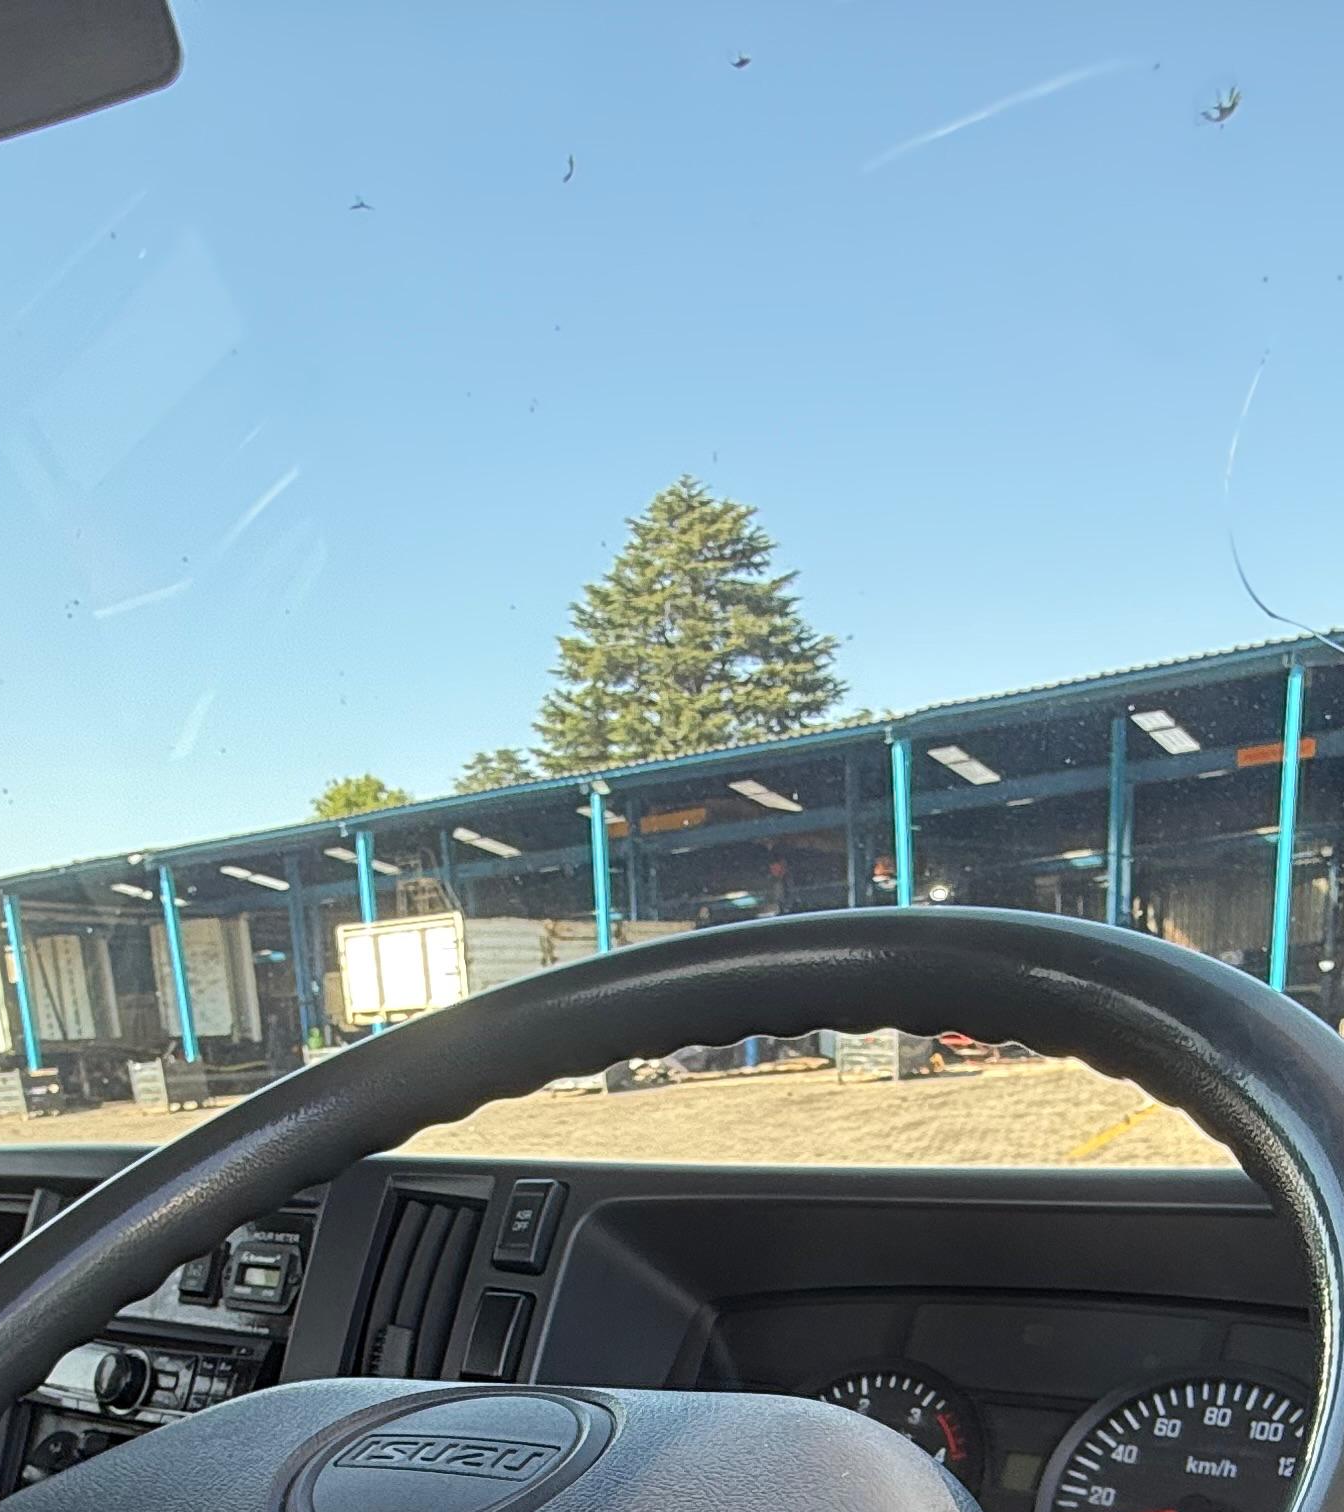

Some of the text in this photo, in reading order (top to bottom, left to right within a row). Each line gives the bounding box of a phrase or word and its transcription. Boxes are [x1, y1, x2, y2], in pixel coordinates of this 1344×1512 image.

[907, 1407, 922, 1425] 3
[1203, 1406, 1232, 1427] 80
[1153, 1418, 1182, 1438] 60
[1249, 1421, 1284, 1442] 100
[354, 1439, 546, 1472] ISUZU
[1111, 1444, 1139, 1465] 40
[1185, 1455, 1238, 1479] km/h
[1277, 1456, 1297, 1478] 12
[1090, 1486, 1116, 1507] 20
